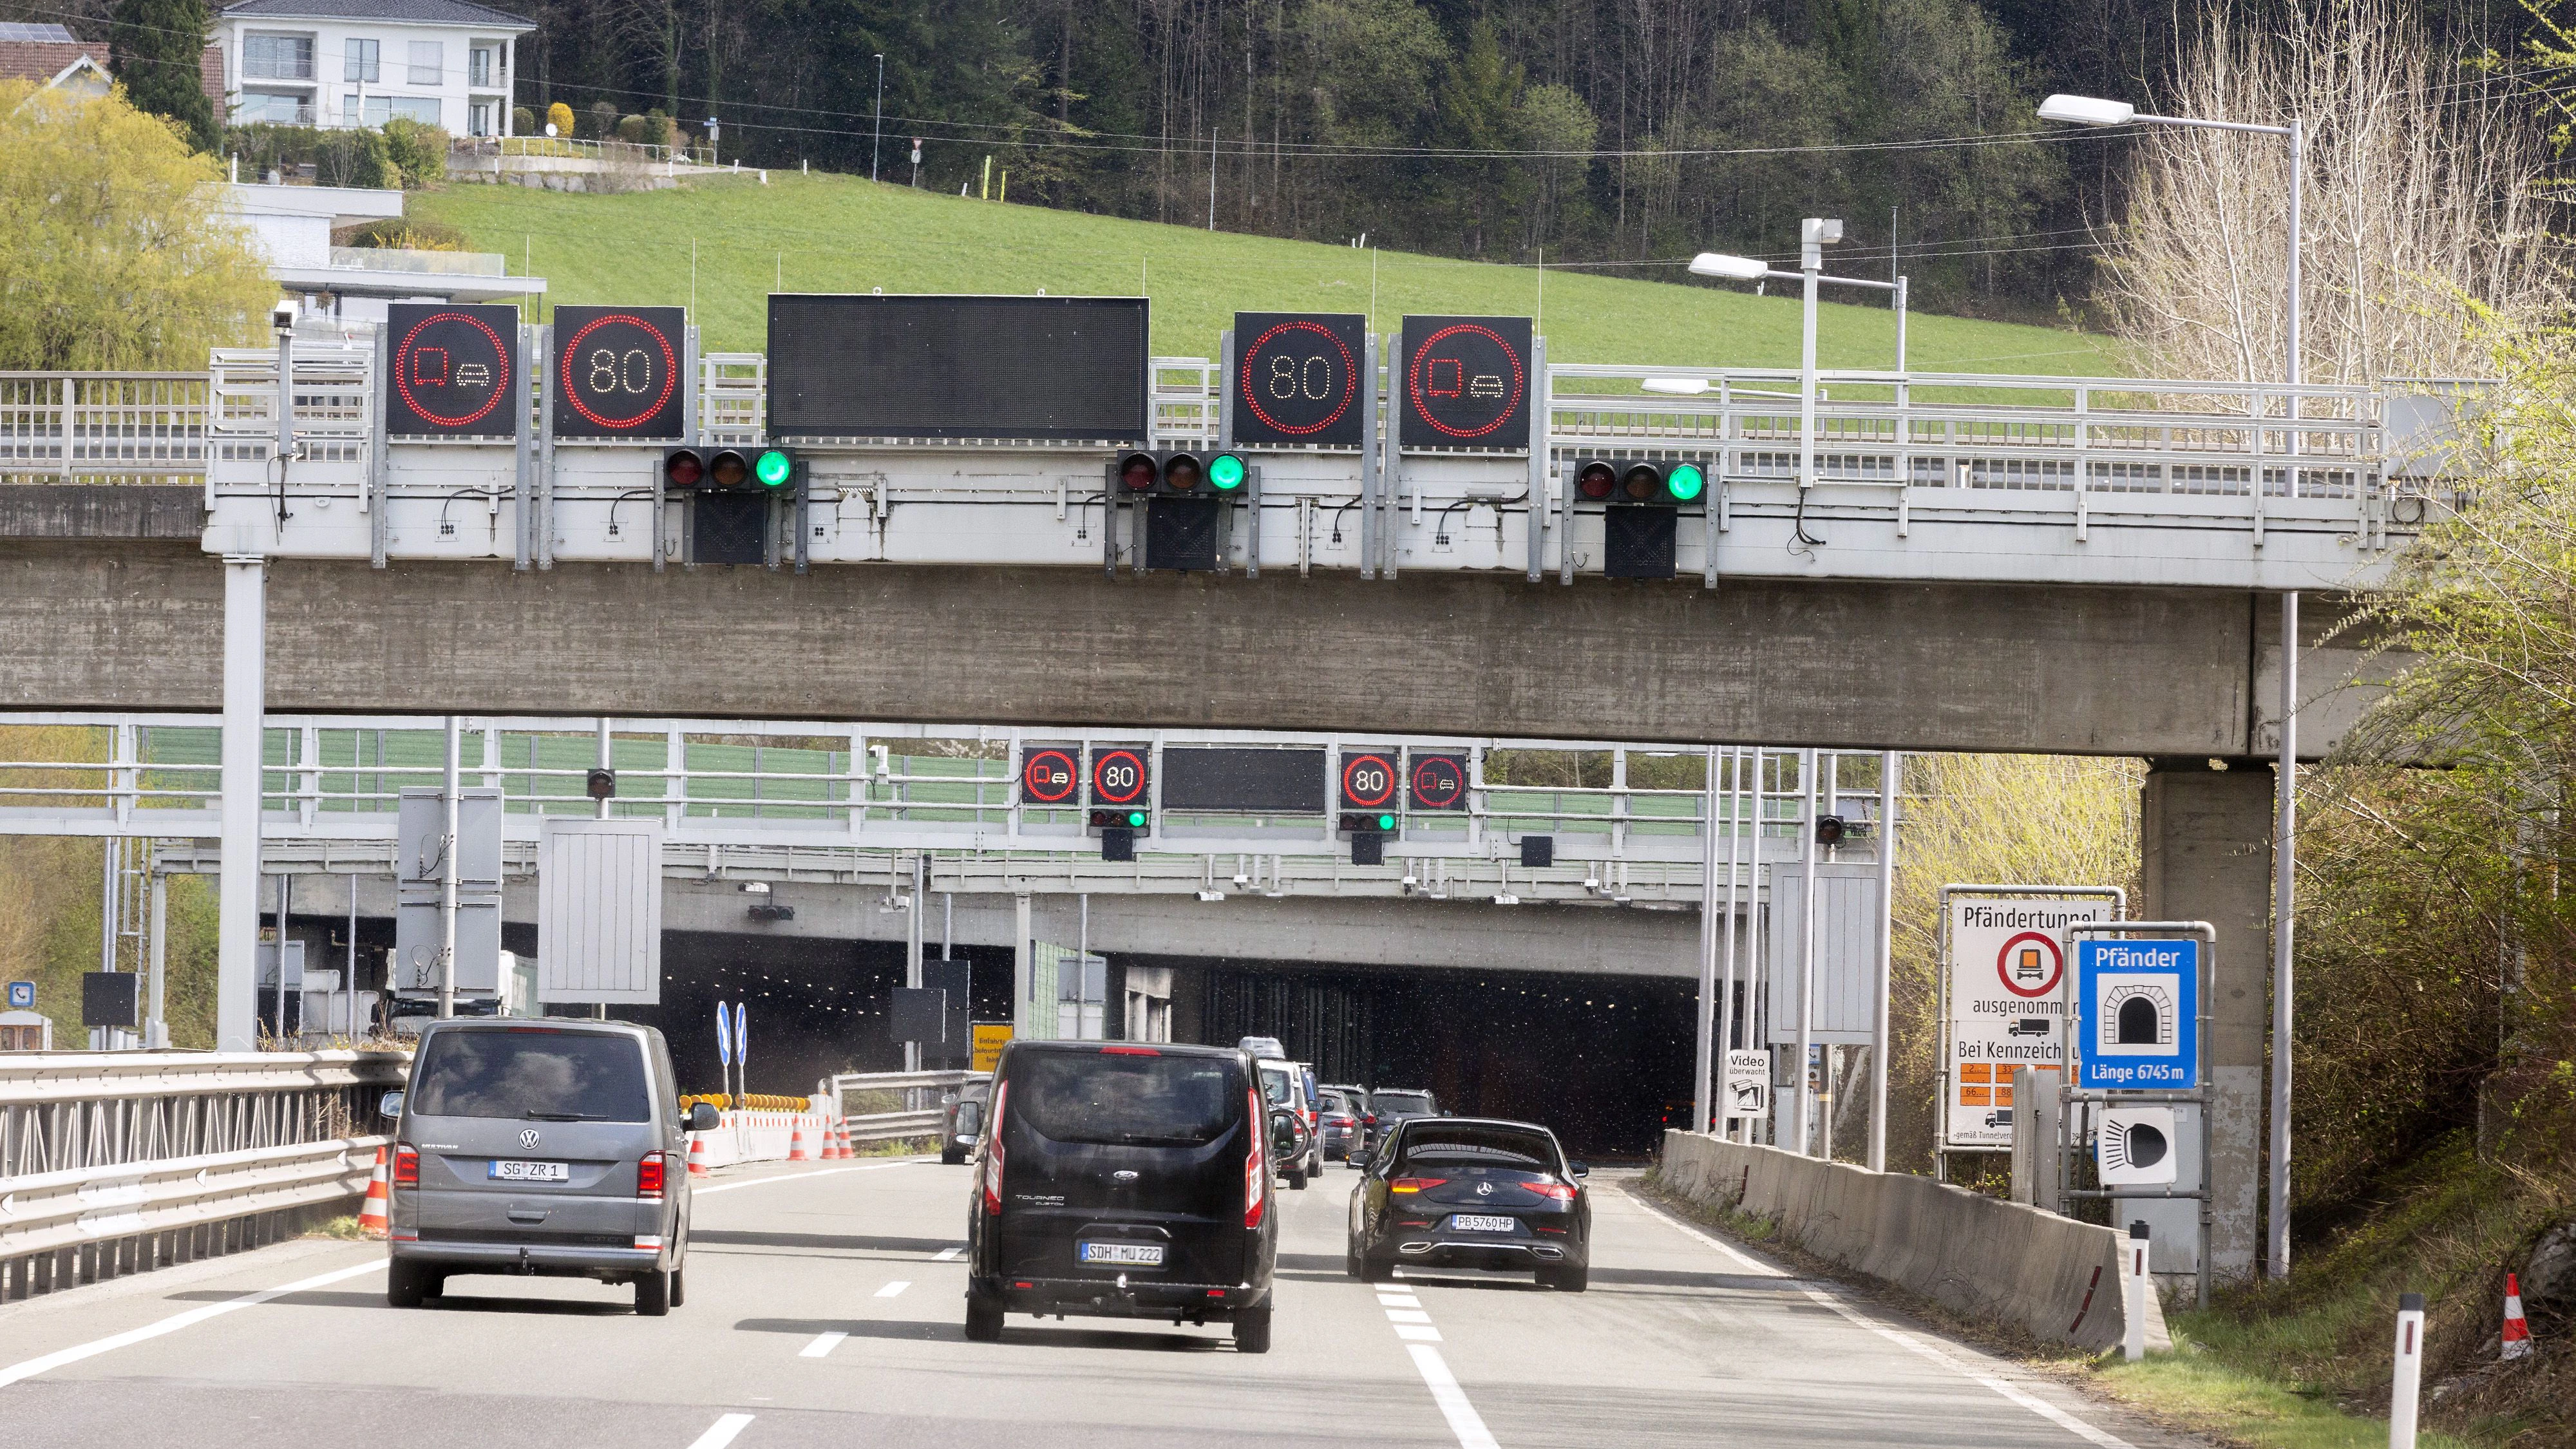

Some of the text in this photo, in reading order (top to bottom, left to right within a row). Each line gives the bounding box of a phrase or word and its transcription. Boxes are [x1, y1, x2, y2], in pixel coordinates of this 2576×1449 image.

[590, 349, 650, 393] 80
[1269, 355, 1331, 399] 80
[1106, 766, 1133, 787] 80
[1356, 770, 1383, 791] 80
[2096, 947, 2181, 967] Pfänder
[1958, 1040, 1981, 1057] Bei
[1730, 1056, 1765, 1066] Video
[1729, 1067, 1765, 1075] überwacht
[2092, 1064, 2184, 1083] Länge 6745 m
[504, 1163, 520, 1175] SG
[529, 1164, 546, 1176] ZR
[551, 1164, 558, 1177] 1
[1458, 1217, 1513, 1228] PB 5760 HP
[1089, 1245, 1112, 1259] SDH
[1121, 1247, 1135, 1260] MU
[1139, 1249, 1159, 1261] 222
